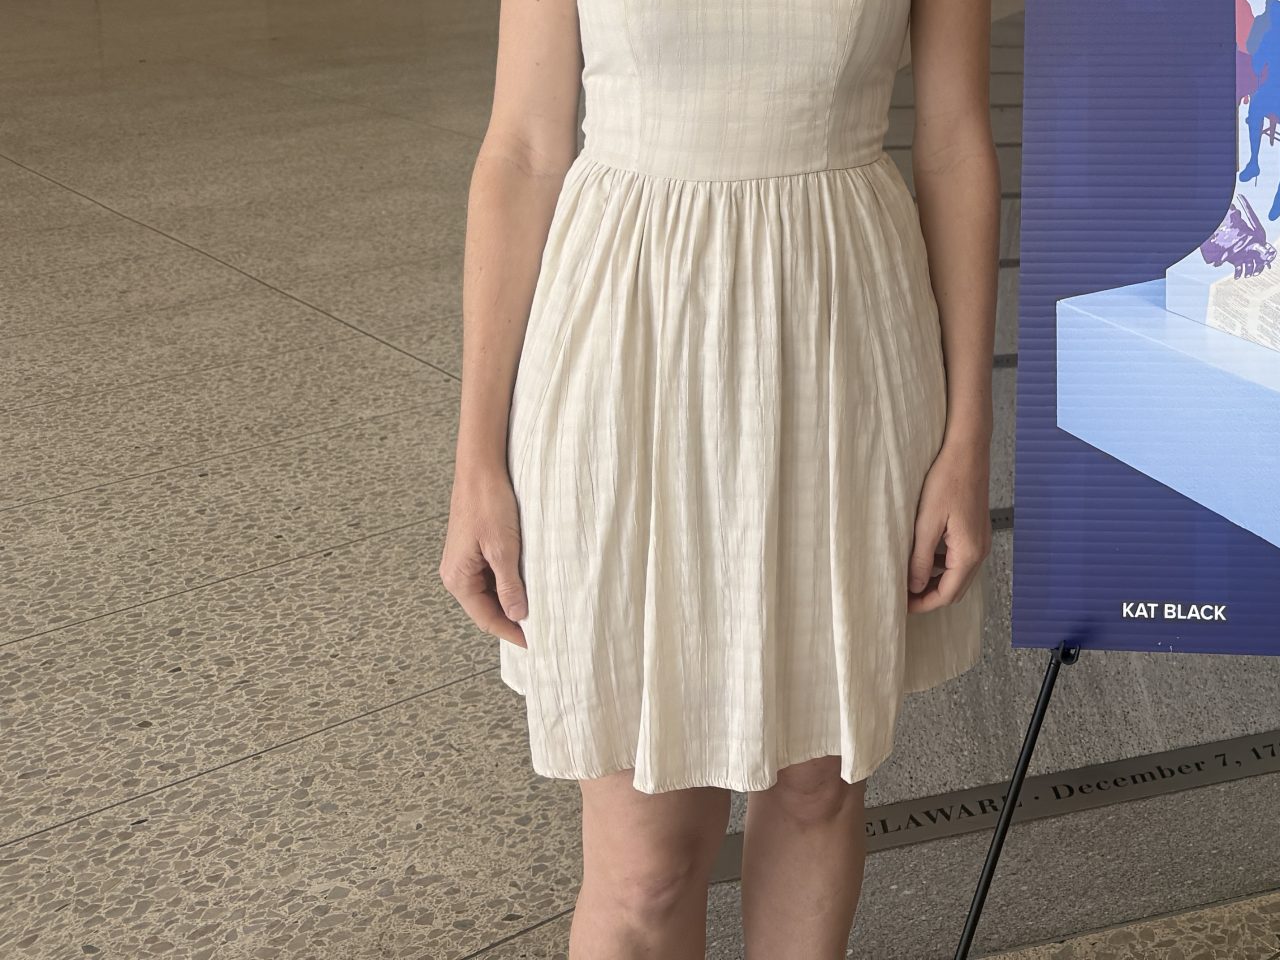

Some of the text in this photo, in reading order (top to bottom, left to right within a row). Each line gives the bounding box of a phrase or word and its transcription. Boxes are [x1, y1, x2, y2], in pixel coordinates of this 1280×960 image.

[1122, 602, 1227, 620] KAT BLACK
[1051, 760, 1205, 801] December
[1214, 752, 1242, 767] 7,
